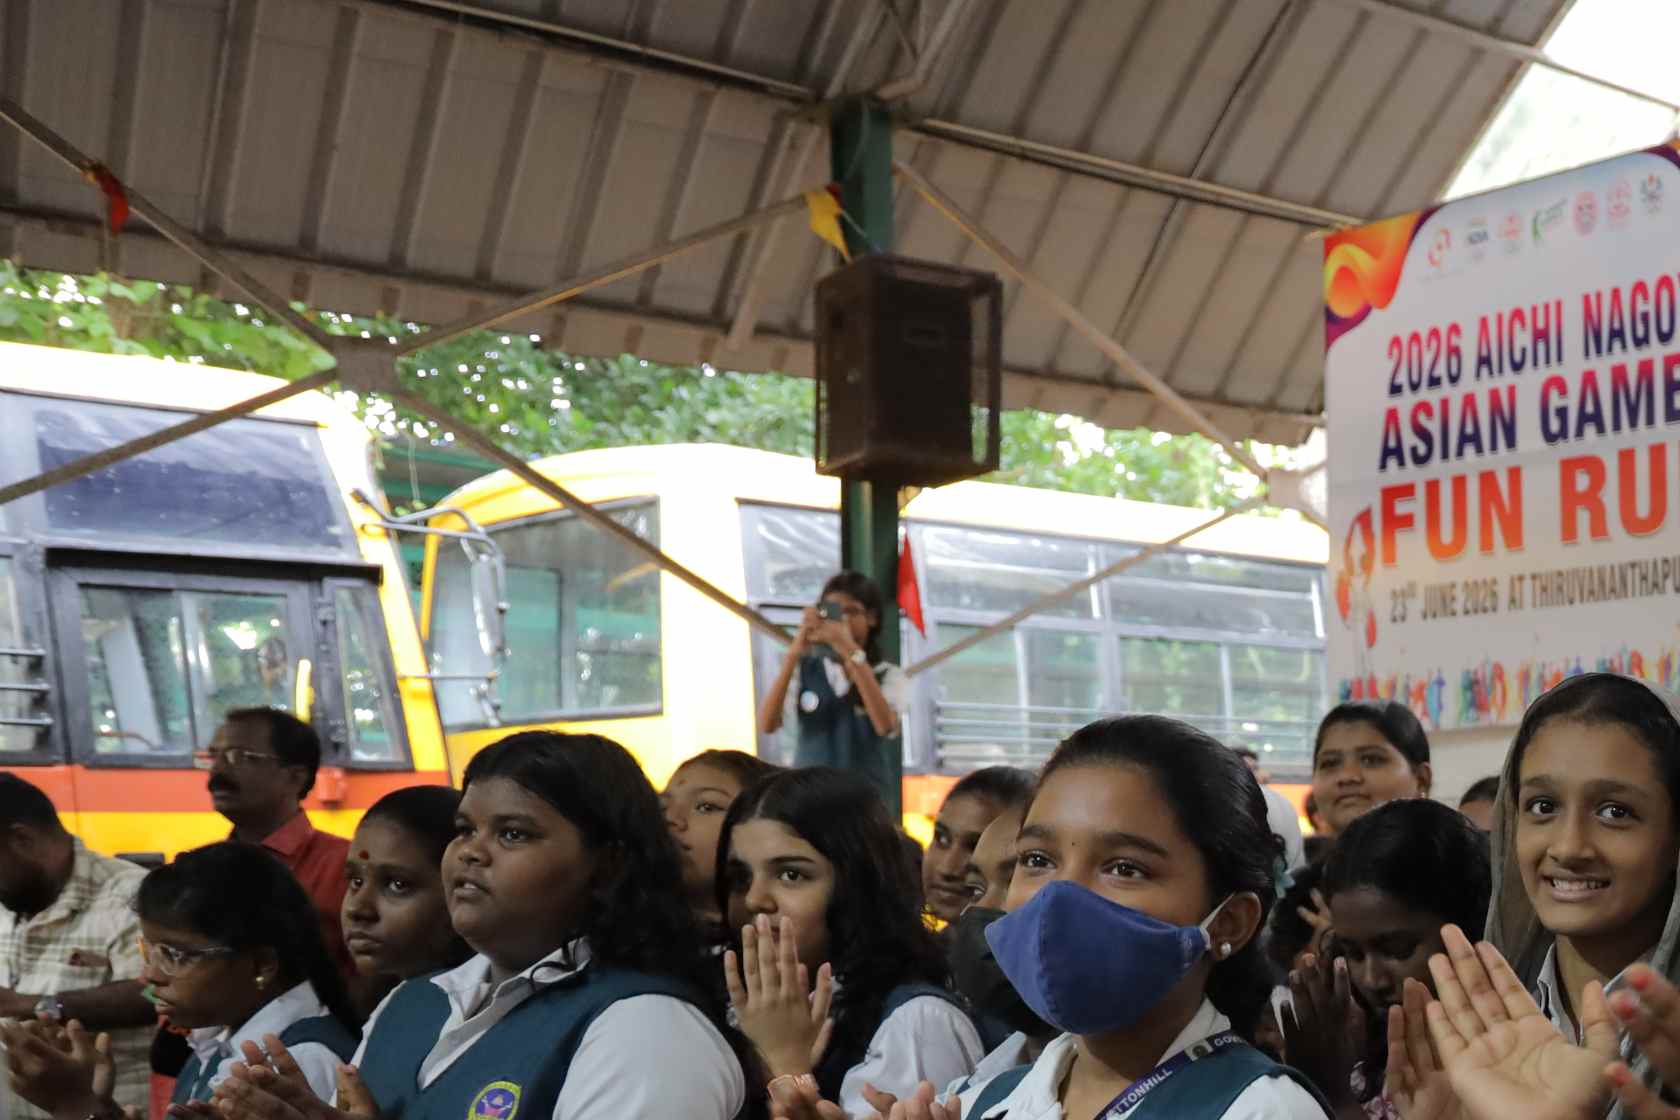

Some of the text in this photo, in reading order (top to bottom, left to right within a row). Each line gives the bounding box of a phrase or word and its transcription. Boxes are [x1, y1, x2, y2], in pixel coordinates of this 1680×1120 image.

[1387, 322, 1464, 399] 2026
[1475, 299, 1564, 381] AICHI
[1379, 383, 1518, 473] ASIAN
[1380, 466, 1524, 570] FUN
[1422, 582, 1457, 620] JUNE
[1508, 574, 1525, 611] AT
